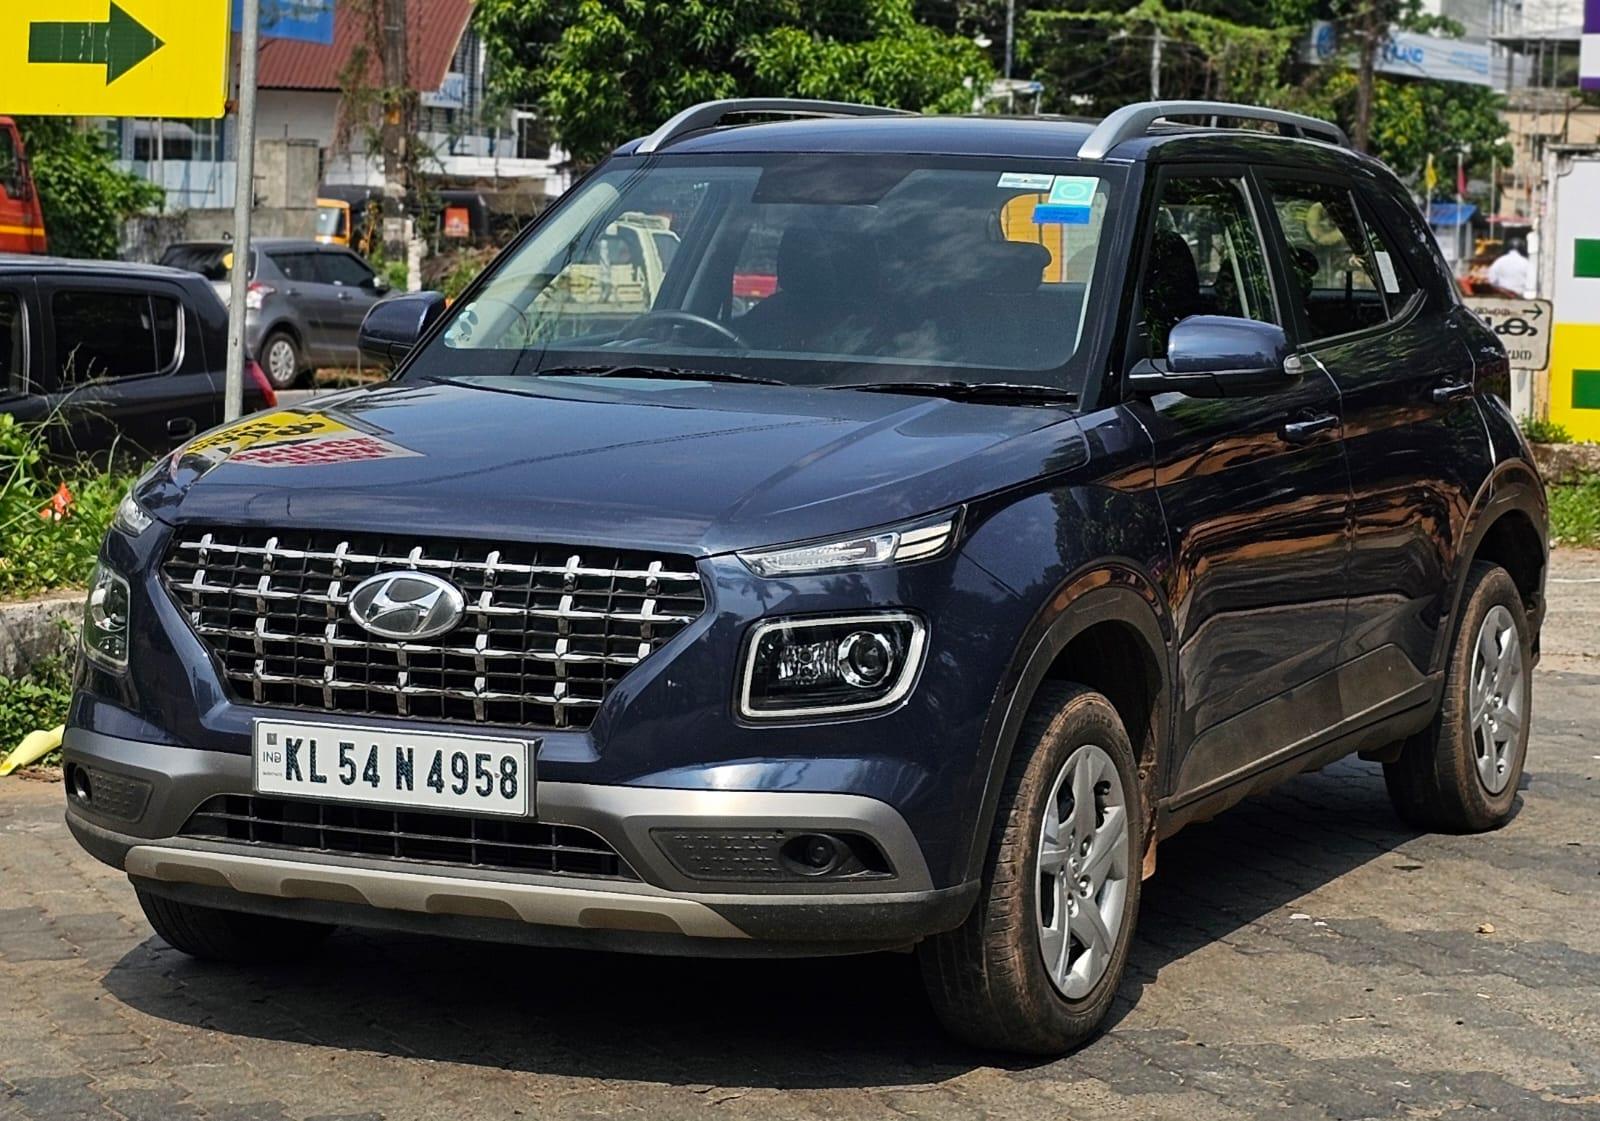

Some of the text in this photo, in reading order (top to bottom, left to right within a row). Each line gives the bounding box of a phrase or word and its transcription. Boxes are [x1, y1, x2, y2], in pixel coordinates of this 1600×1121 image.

[286, 738, 518, 799] KL 54 N 4958
